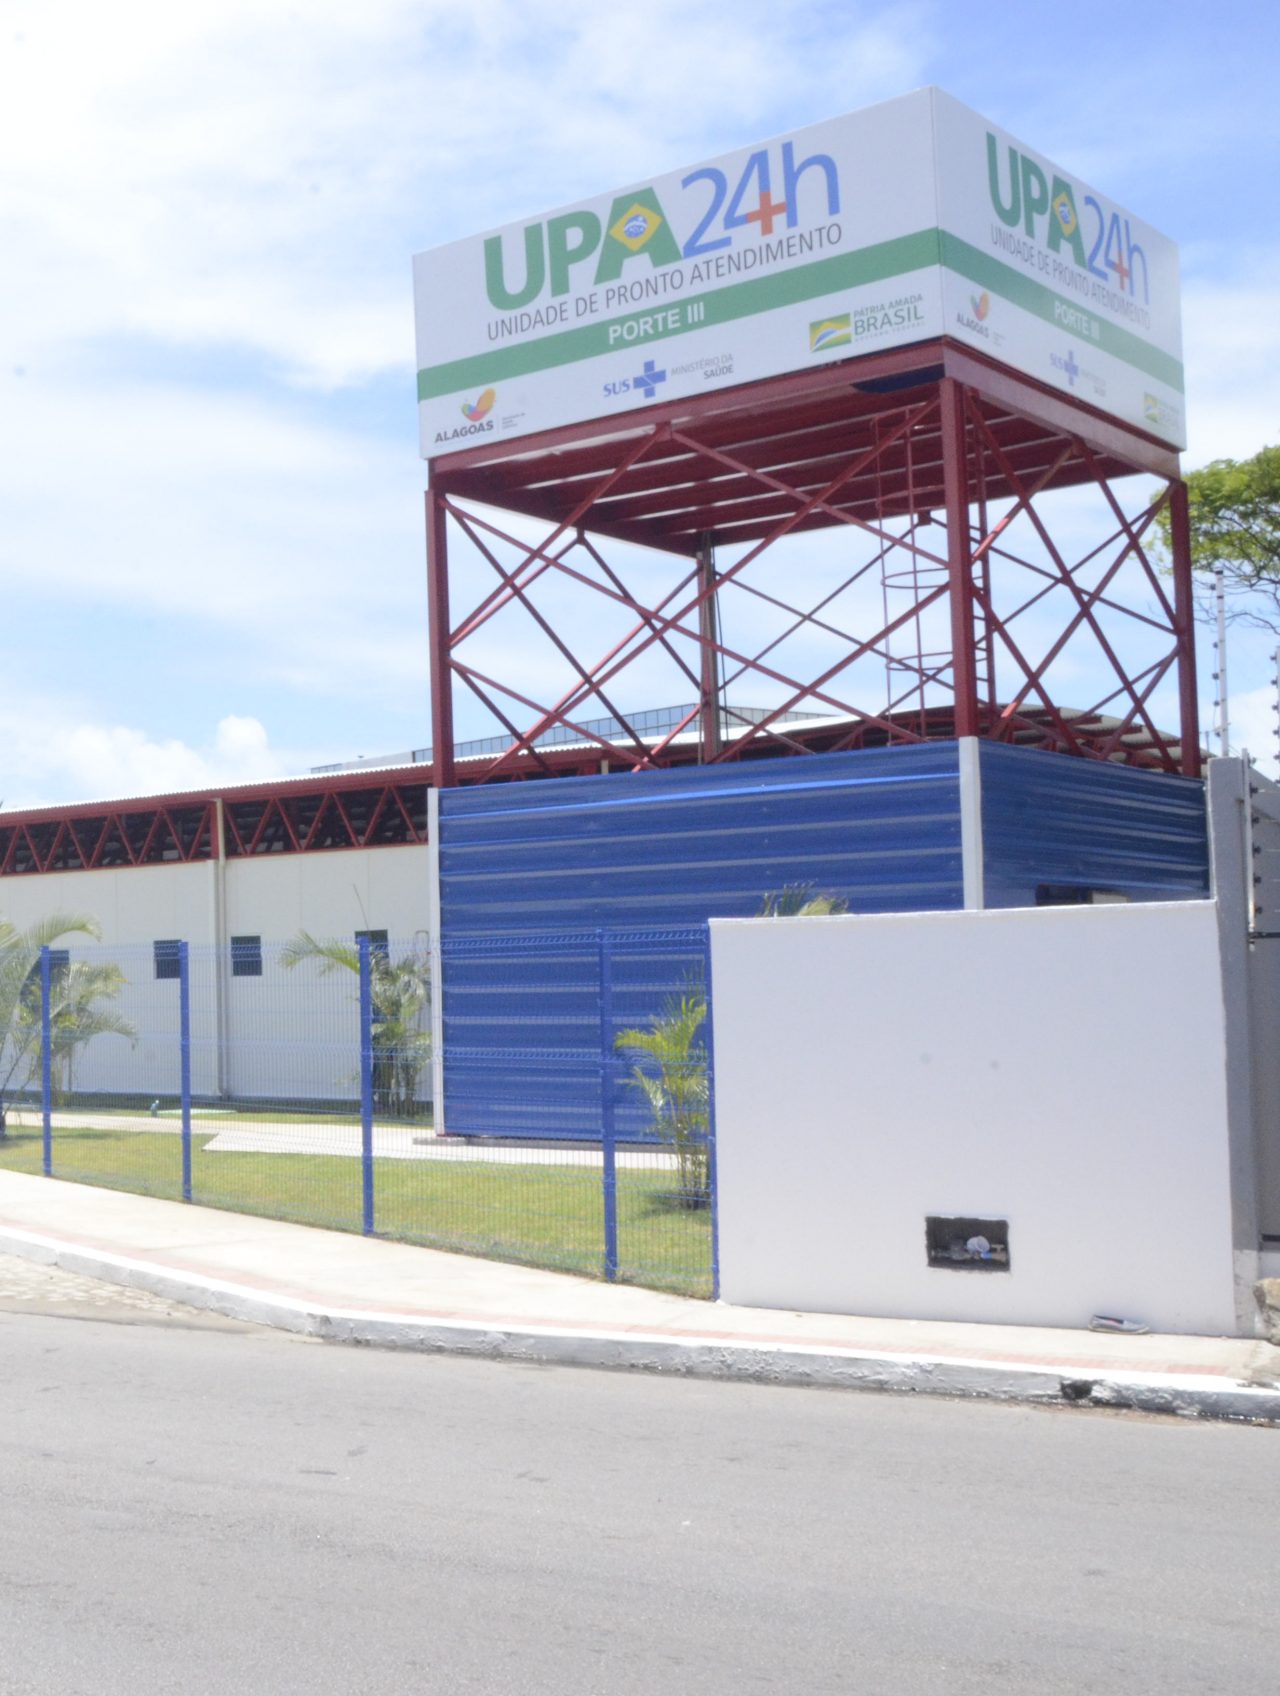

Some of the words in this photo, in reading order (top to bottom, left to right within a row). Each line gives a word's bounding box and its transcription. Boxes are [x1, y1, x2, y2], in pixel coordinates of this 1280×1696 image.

[483, 186, 683, 311] UPA
[681, 141, 841, 260] 24h
[986, 131, 1090, 270] UPA
[1085, 195, 1150, 305] 24h
[487, 302, 570, 341] UNIDADE
[575, 294, 599, 317] DE
[606, 268, 684, 309] PRONTO
[689, 222, 843, 285] ATENDIMENTO
[991, 224, 1035, 267] UNIDADE
[1037, 248, 1051, 276] DE
[1053, 259, 1090, 297] PRONTO
[1091, 280, 1151, 331] ATENDIMENTO
[888, 293, 924, 310] AMADA
[1054, 300, 1090, 336] PORTE
[609, 310, 681, 345] PORTE
[687, 302, 705, 324] III
[854, 305, 925, 336] BRASIL
[670, 357, 720, 377] MINISTÉRIO
[721, 353, 734, 365] DA
[703, 364, 734, 380] SAÚDE
[603, 378, 631, 398] SUS
[434, 420, 494, 443] ALAGOAS
